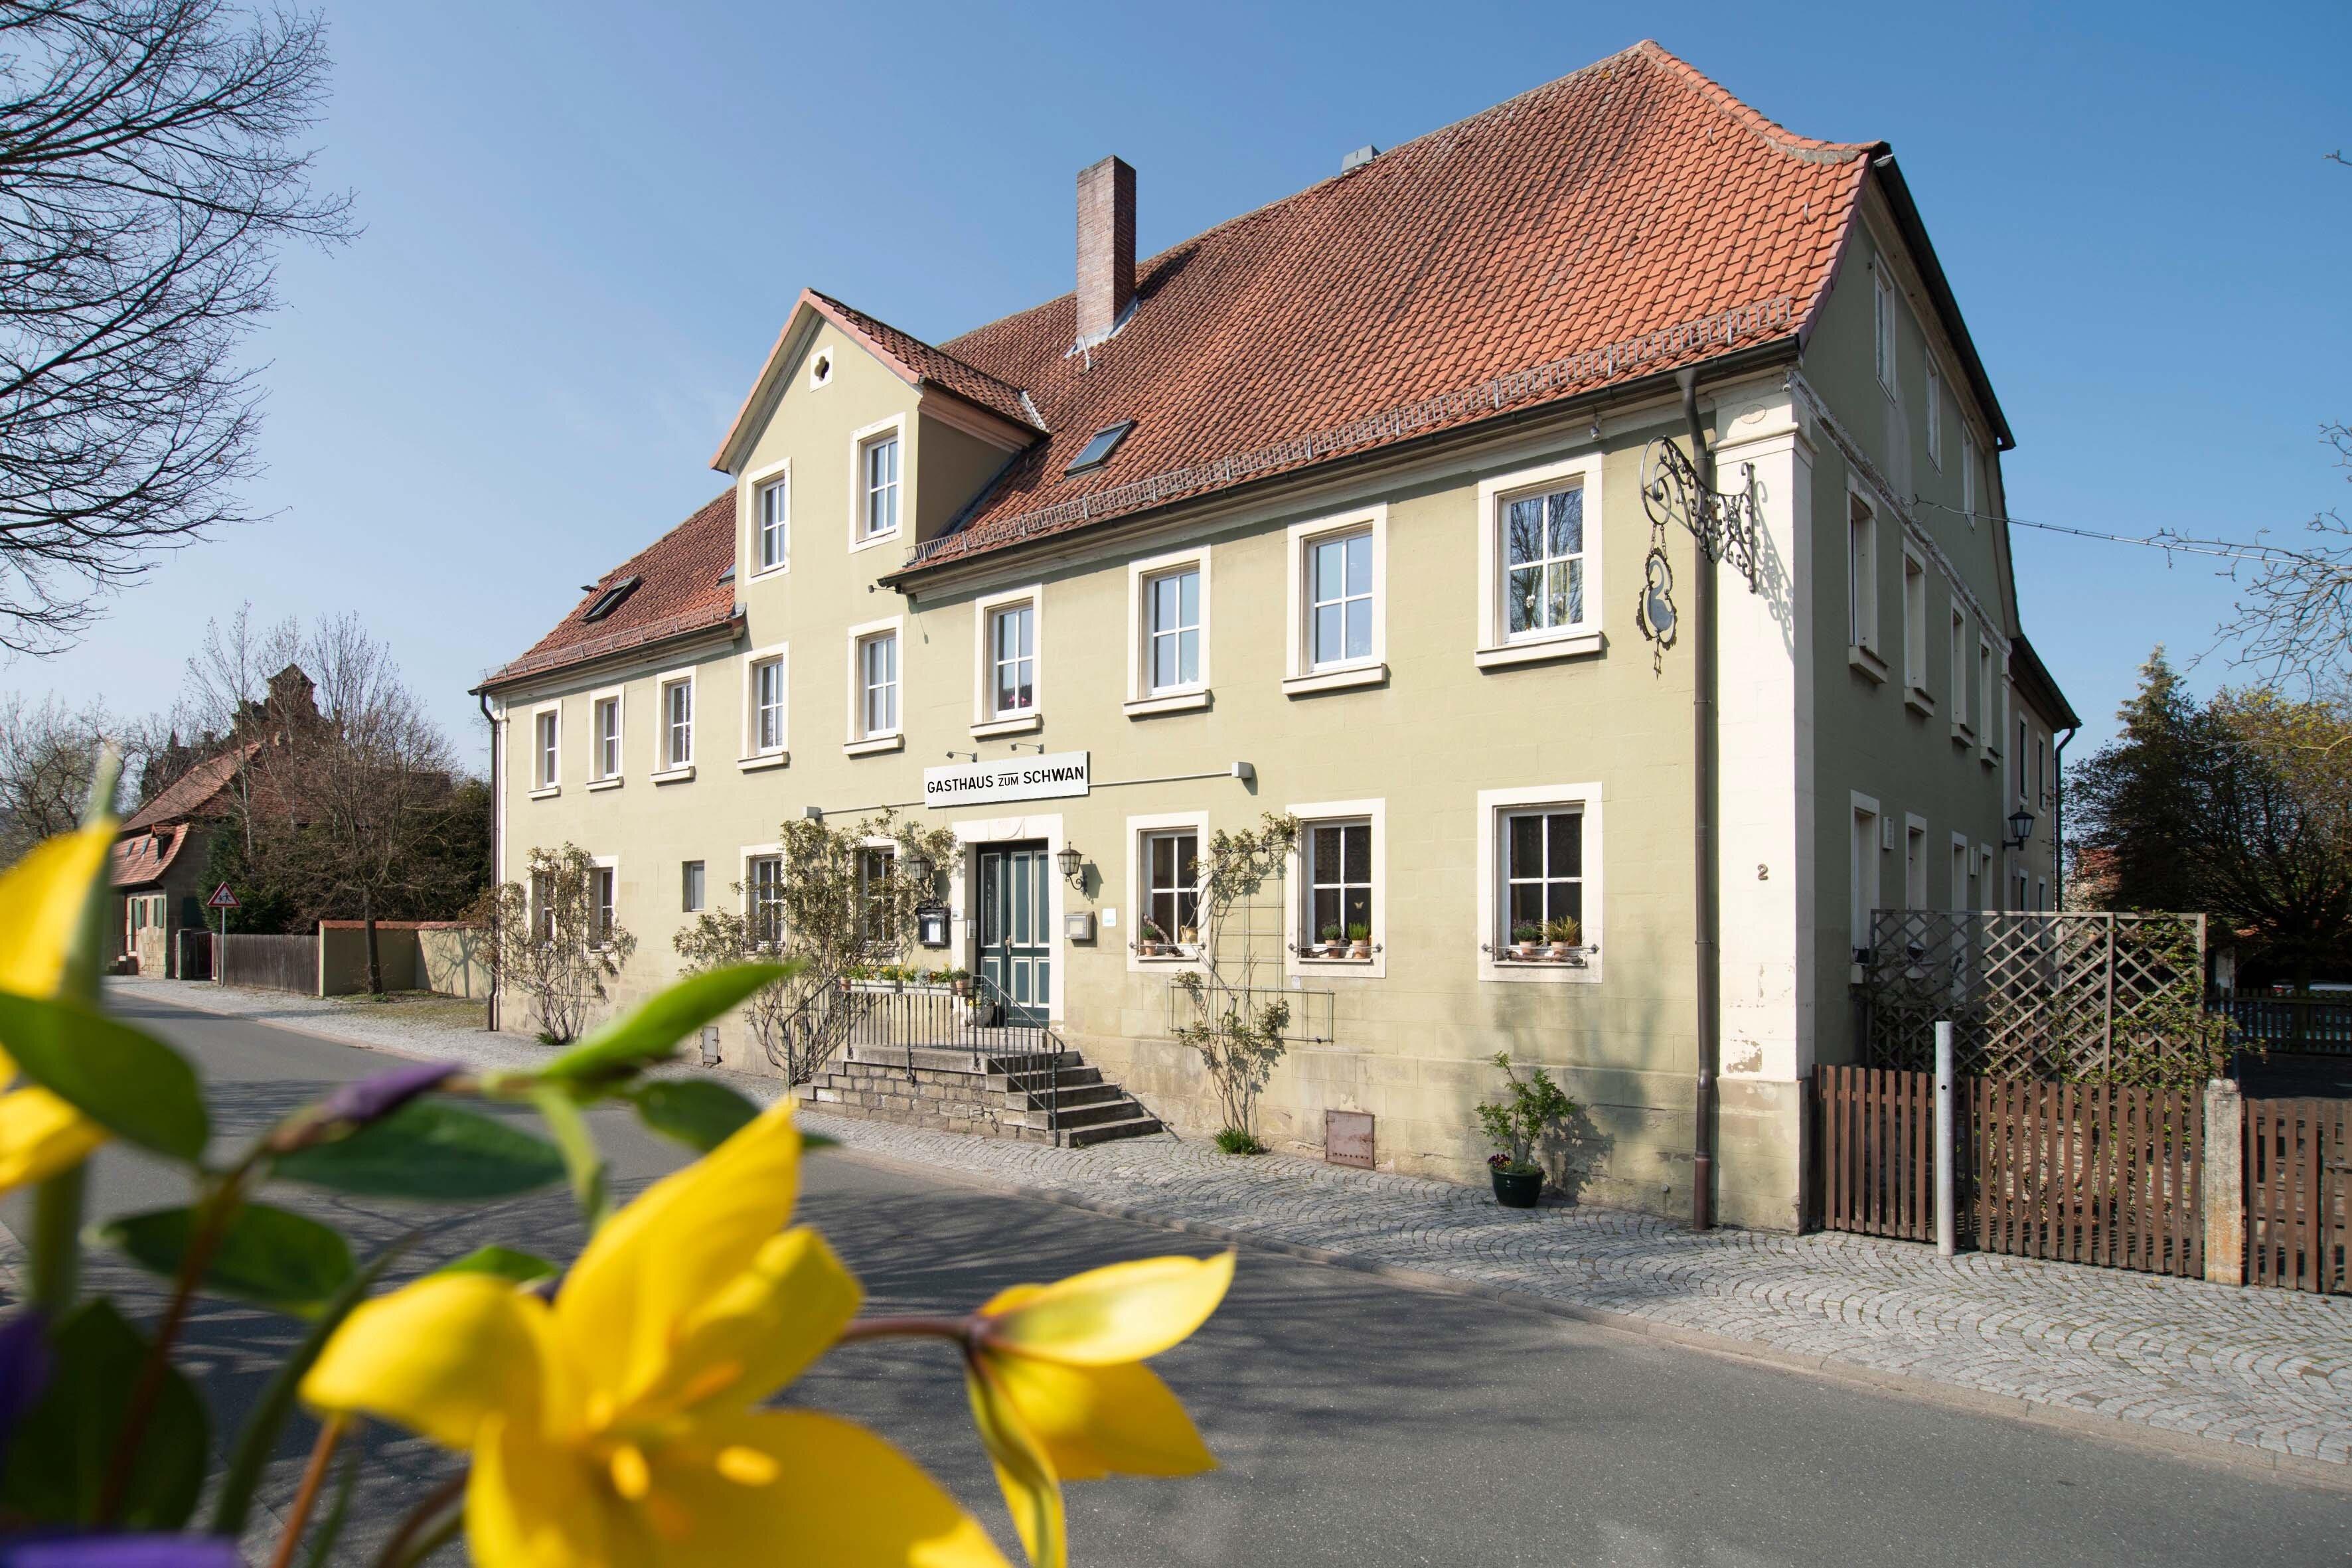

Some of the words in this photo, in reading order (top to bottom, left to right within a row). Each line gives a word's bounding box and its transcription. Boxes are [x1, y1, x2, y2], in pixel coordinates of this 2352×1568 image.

[927, 775, 994, 793] GASTHAUS
[998, 776, 1019, 787] ZUM
[1023, 765, 1084, 785] SCHWAN
[1757, 864, 1768, 880] 2
